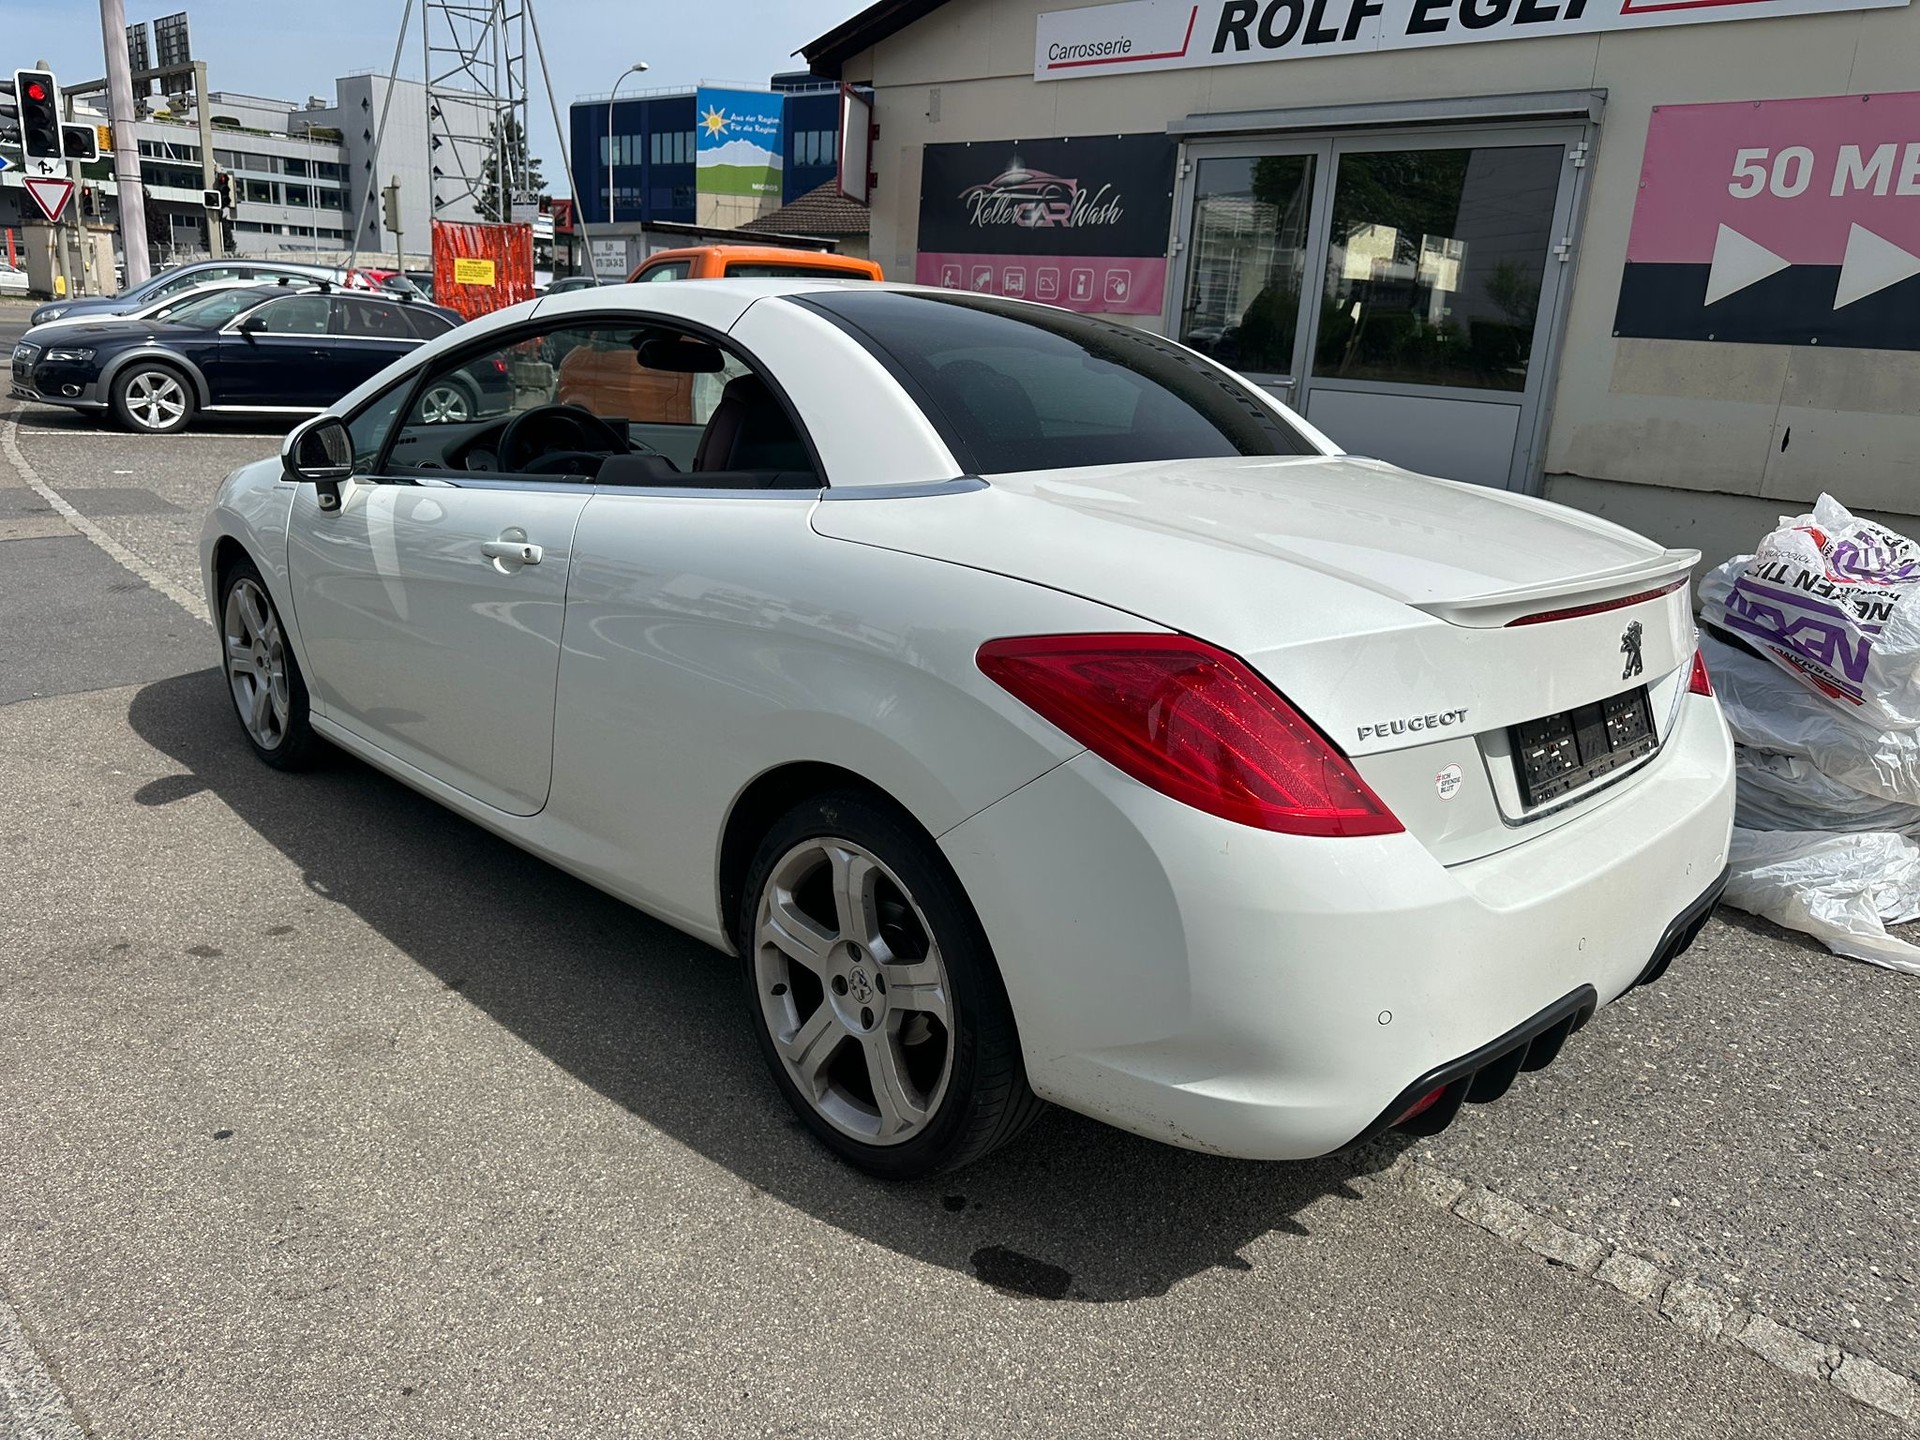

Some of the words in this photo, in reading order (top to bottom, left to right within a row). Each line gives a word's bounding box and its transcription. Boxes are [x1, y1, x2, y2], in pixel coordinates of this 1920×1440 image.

[1211, 0, 1382, 54] ROLF
[1049, 36, 1132, 61] Carrosserie
[731, 113, 744, 122] Aus
[745, 115, 756, 123] der
[731, 123, 742, 131] Für
[1728, 146, 1815, 199] 50
[752, 183, 778, 192] MIGROS
[966, 186, 1022, 228] Keller
[1016, 202, 1073, 228] CAR
[1070, 183, 1123, 228] Wash
[1357, 708, 1469, 742] PEUGEOT
[1440, 784, 1454, 794] BLUT
[1441, 776, 1461, 787] SPENDE
